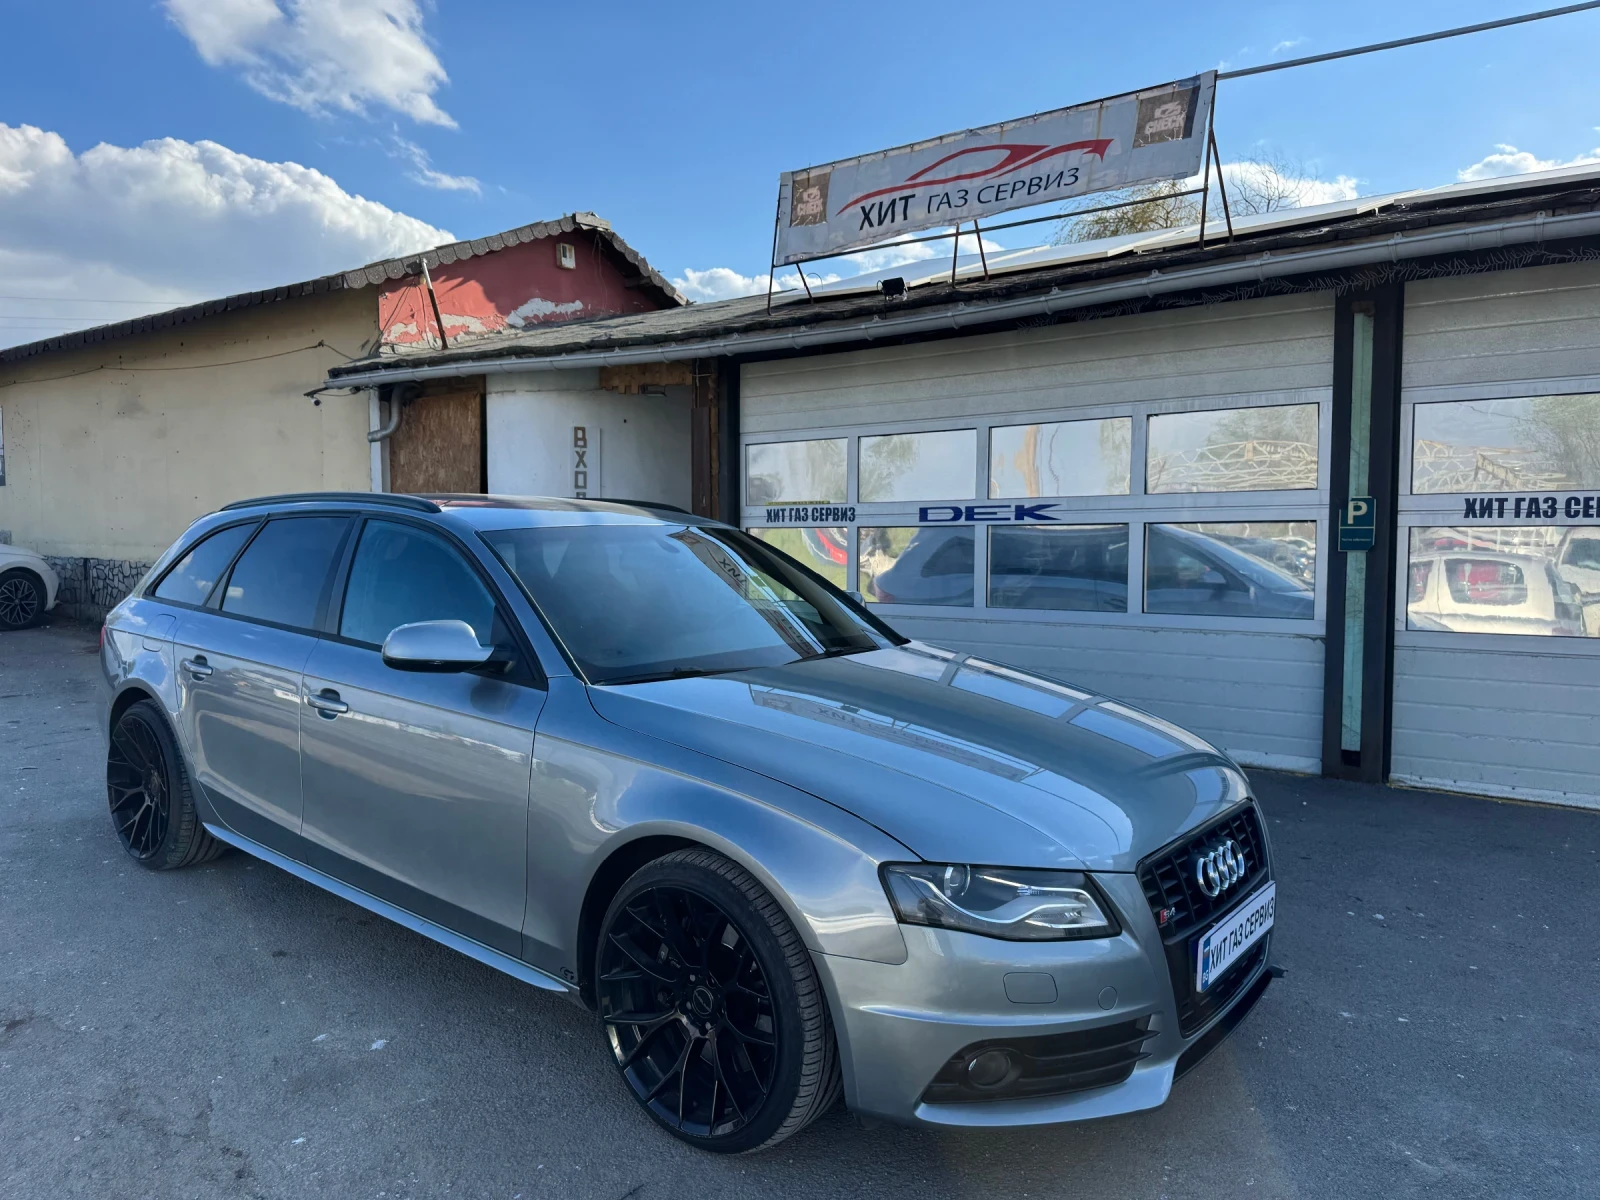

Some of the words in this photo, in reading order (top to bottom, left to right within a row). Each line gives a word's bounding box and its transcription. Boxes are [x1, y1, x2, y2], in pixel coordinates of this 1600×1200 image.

[859, 194, 916, 231] ХИТ
[927, 189, 969, 214] ГАЗ
[977, 167, 1080, 204] СЕРВИЗ
[766, 508, 786, 523] ХИТ
[789, 507, 809, 522] ГАЗ
[811, 507, 856, 522] СЕРВИЗ
[919, 504, 1062, 522] DEK
[1347, 501, 1368, 525] P
[1464, 498, 1508, 519] ХИТ
[1514, 497, 1557, 519] ГАЗ
[1564, 496, 1600, 518] СЕ
[1210, 936, 1228, 973] ХИТ
[1229, 923, 1243, 955] ГАЗ
[1244, 896, 1274, 940] СЕРВИЗ
